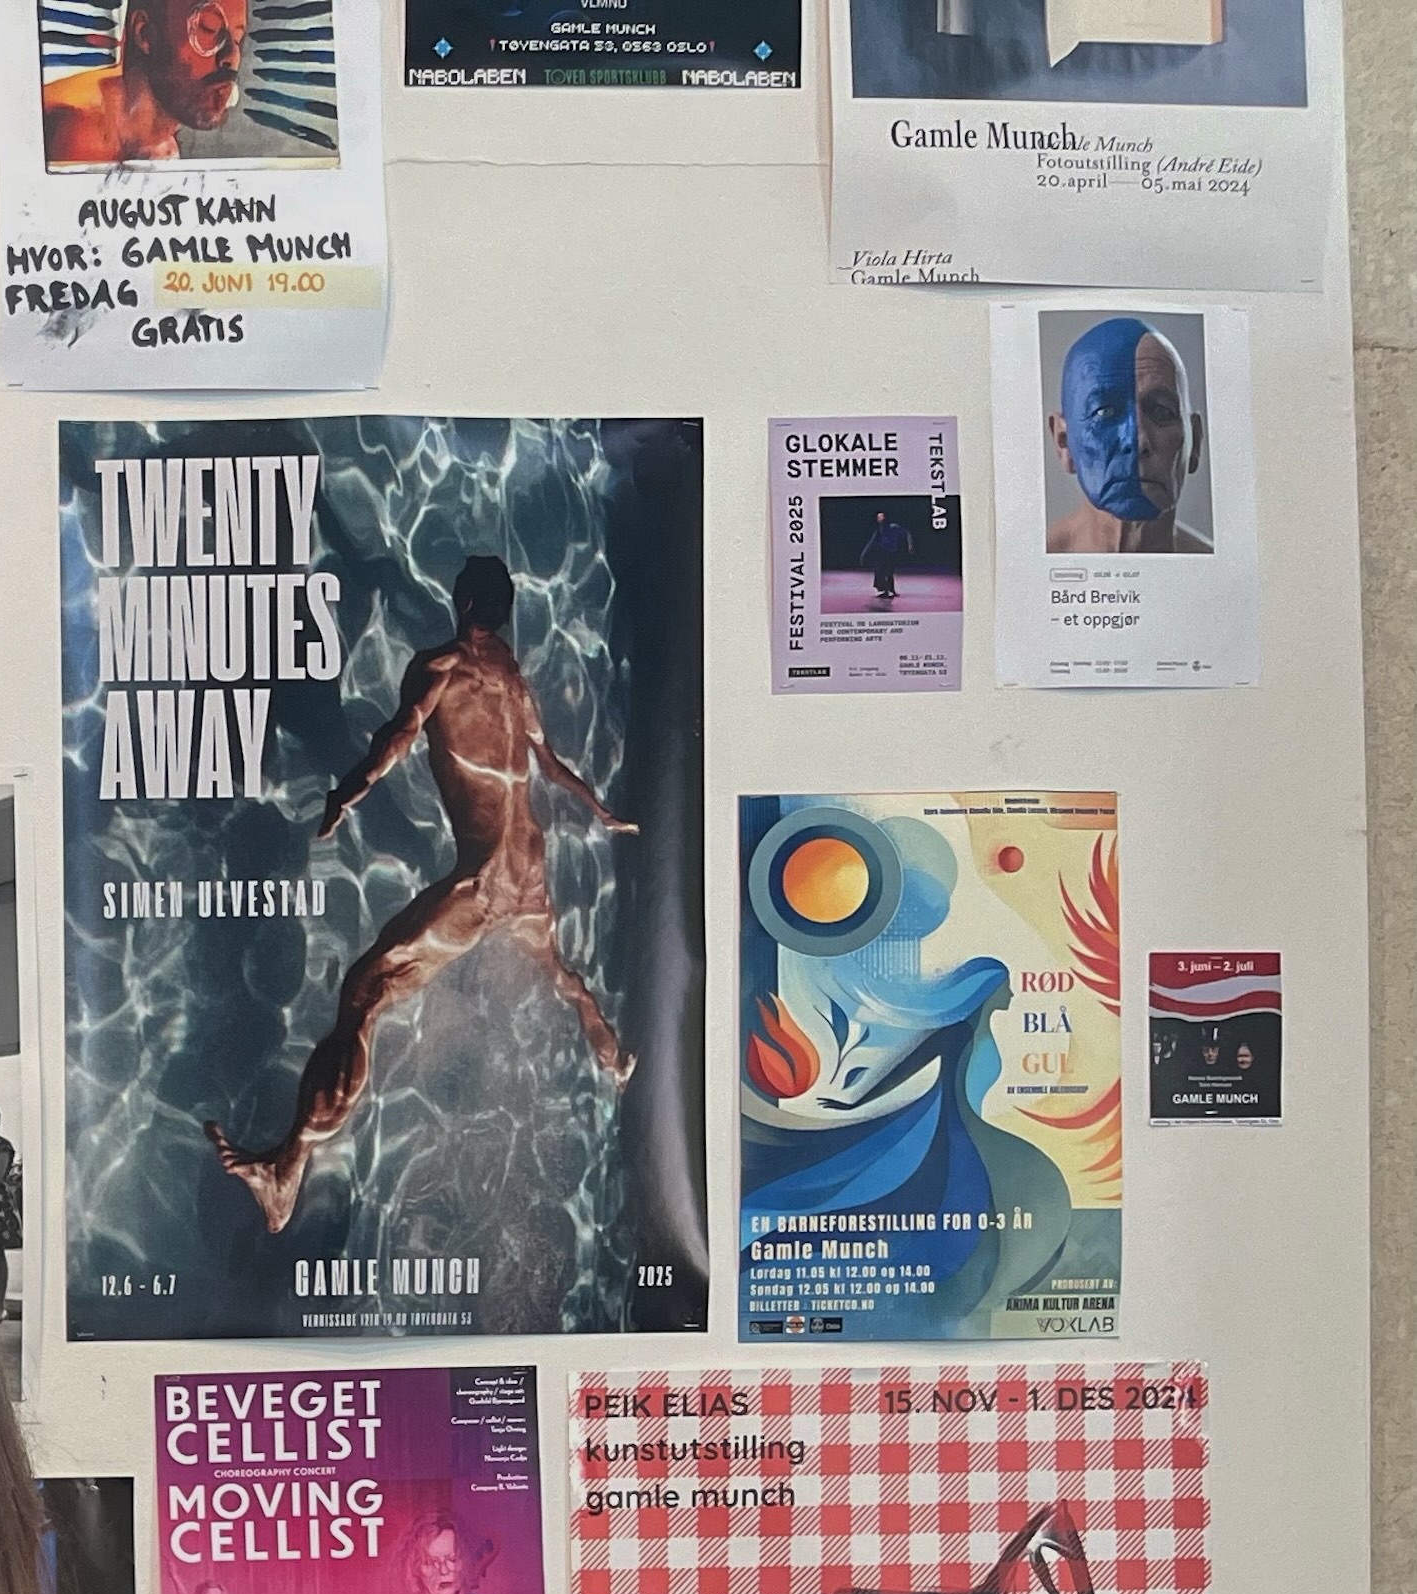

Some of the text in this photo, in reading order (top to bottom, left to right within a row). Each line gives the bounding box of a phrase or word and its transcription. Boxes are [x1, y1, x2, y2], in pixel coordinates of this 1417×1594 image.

[551, 23, 655, 35] GAMLE MUNCH
[891, 120, 1076, 150] Gamle Munch
[1037, 153, 1262, 177] Fotoutstilling (André Eide)
[79, 194, 275, 228] AUGUST KANN
[7, 232, 351, 275] HVOR: GAMLE MUNCH
[5, 280, 138, 315] FREDAG
[133, 315, 244, 348] GRATIS
[785, 433, 898, 452] GLOKALE
[786, 458, 898, 478] STEMMER
[95, 455, 319, 568] TWENTY
[789, 496, 804, 650] FESTIVAL 2025
[1052, 589, 1140, 605] Bård Breivik
[98, 572, 341, 682] MINUTES
[99, 688, 271, 799] AWAY
[103, 880, 325, 918] SIMEN ULVESTAD
[1021, 972, 1074, 993] RØD
[1023, 1007, 1072, 1034] BLÅ
[1023, 1052, 1072, 1075] GUL
[1173, 1094, 1258, 1104] GAMLE MUNCH
[752, 1207, 1032, 1232] EN BARNEFORESTILLING FOR 0-3 ÅR
[751, 1239, 888, 1261] Gamle Munch
[295, 1258, 479, 1297] GAMLE MUNCH
[638, 1266, 673, 1287] 2025
[1039, 1317, 1114, 1332] VOXLAB
[166, 1380, 381, 1421] BEVEGET
[585, 1393, 749, 1417] PEIK ELIAS
[167, 1418, 381, 1465] CELLIST
[586, 1436, 805, 1464] kunstutstilling
[214, 1467, 336, 1478] CHOREOGRAPHY CONCERT
[169, 1479, 383, 1520] MOVING
[586, 1483, 795, 1516] gamle munch
[170, 1518, 384, 1564] CELLIST
